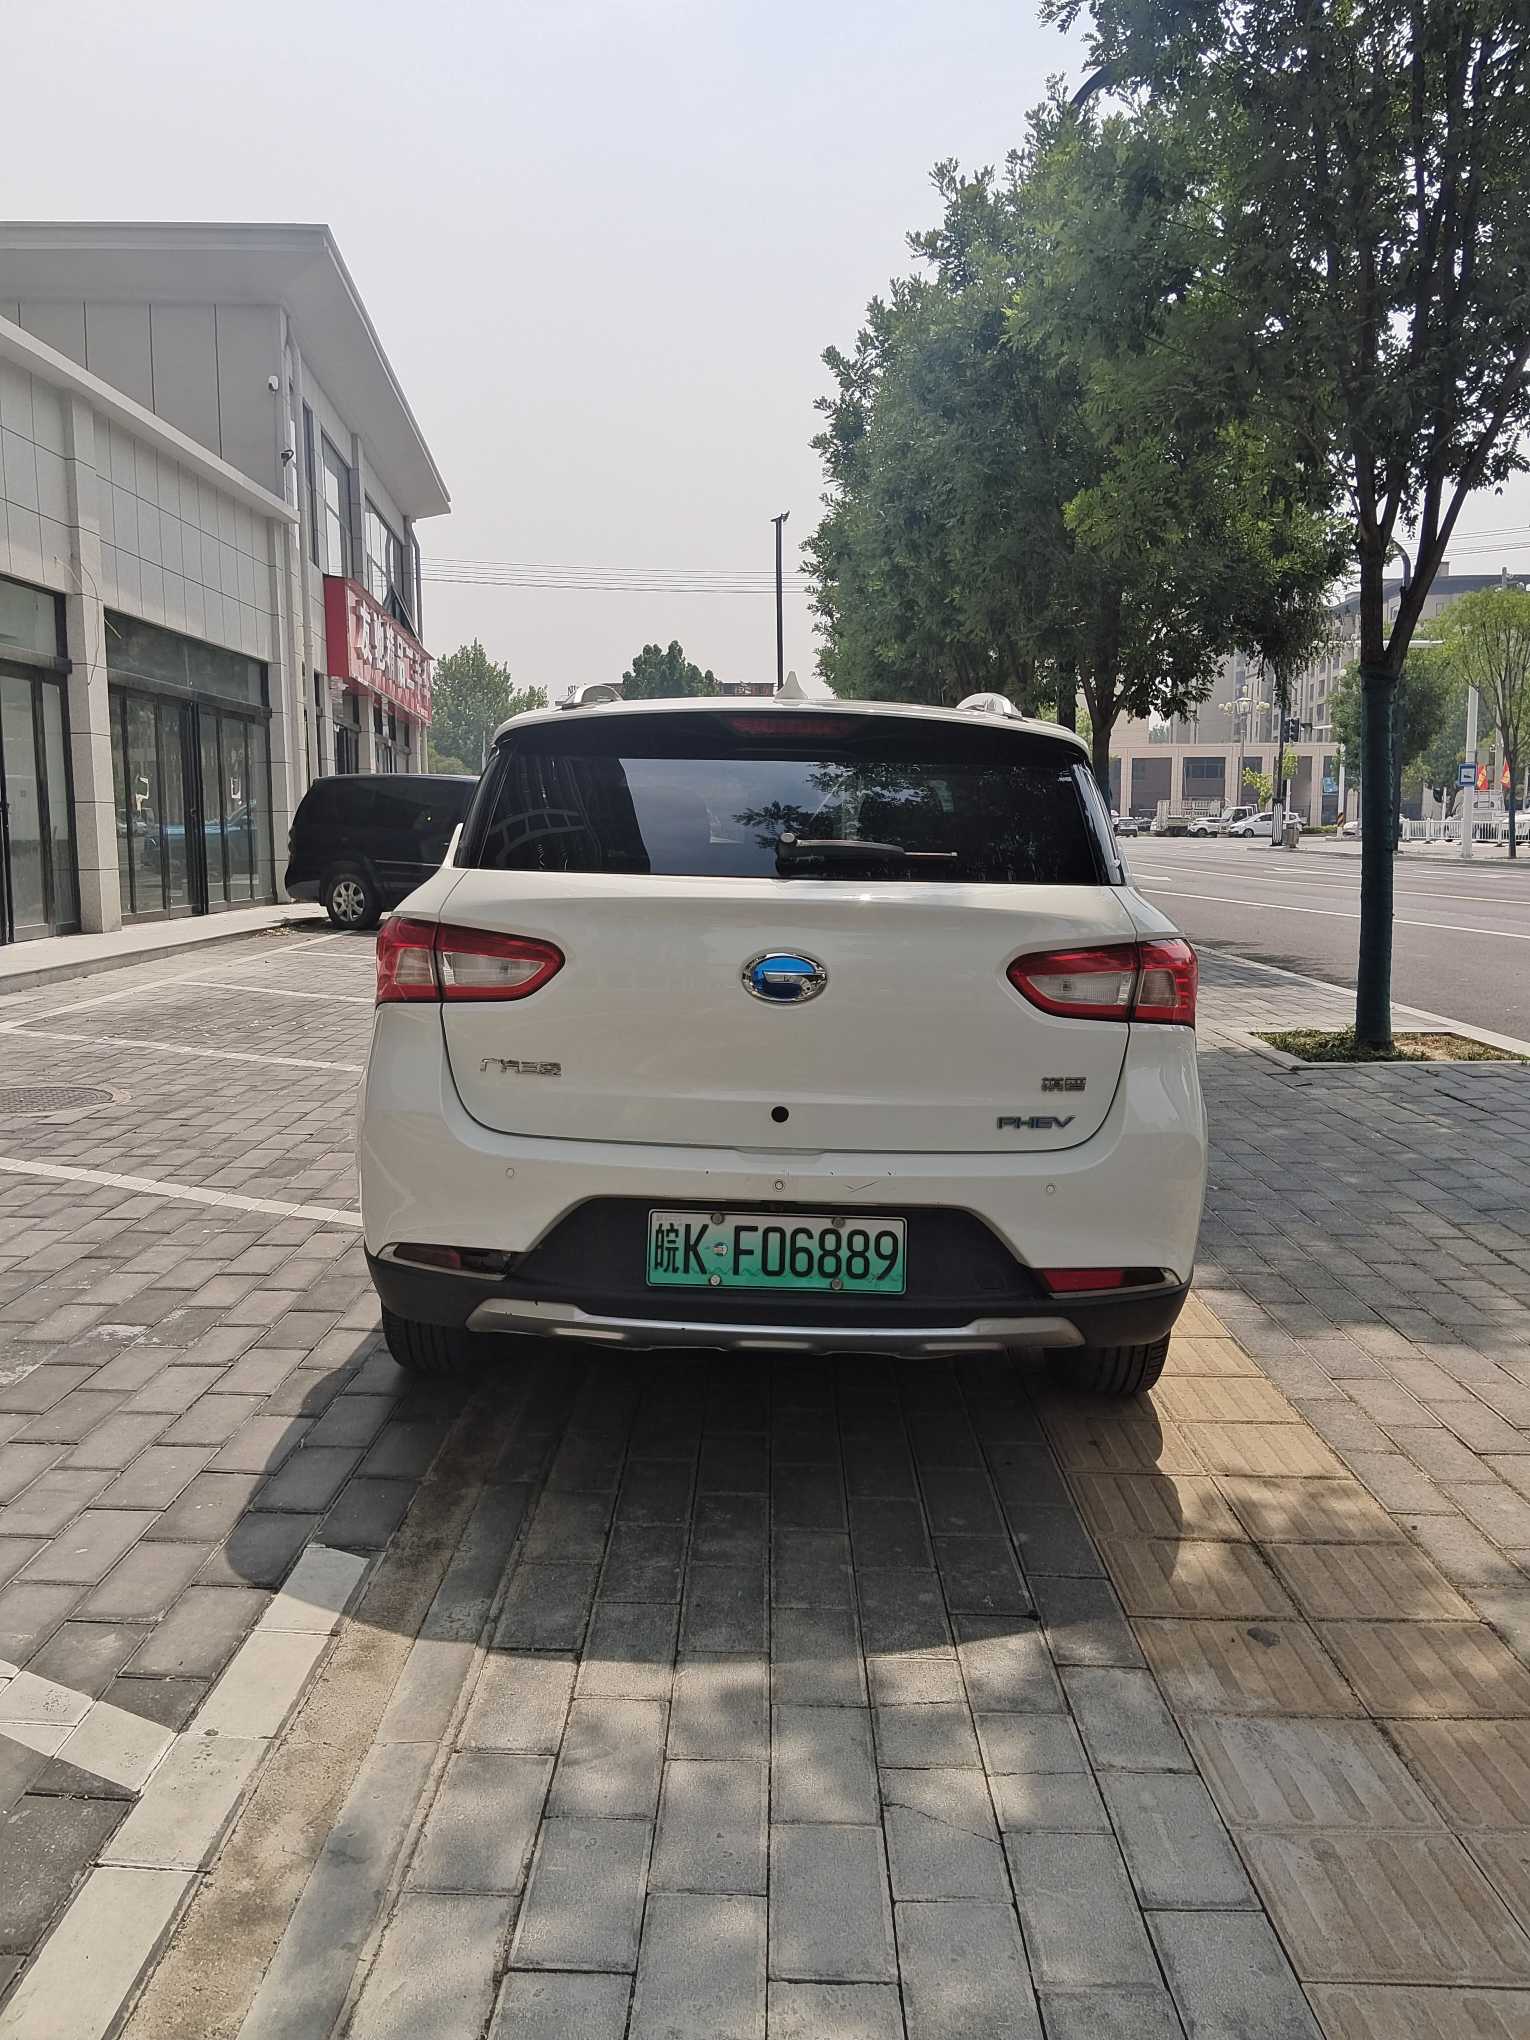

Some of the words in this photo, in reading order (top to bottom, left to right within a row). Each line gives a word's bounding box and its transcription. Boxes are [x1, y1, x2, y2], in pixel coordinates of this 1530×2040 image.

[997, 1114, 1076, 1129] PHEV
[654, 1222, 710, 1275] 皖K
[732, 1225, 899, 1281] F06889
